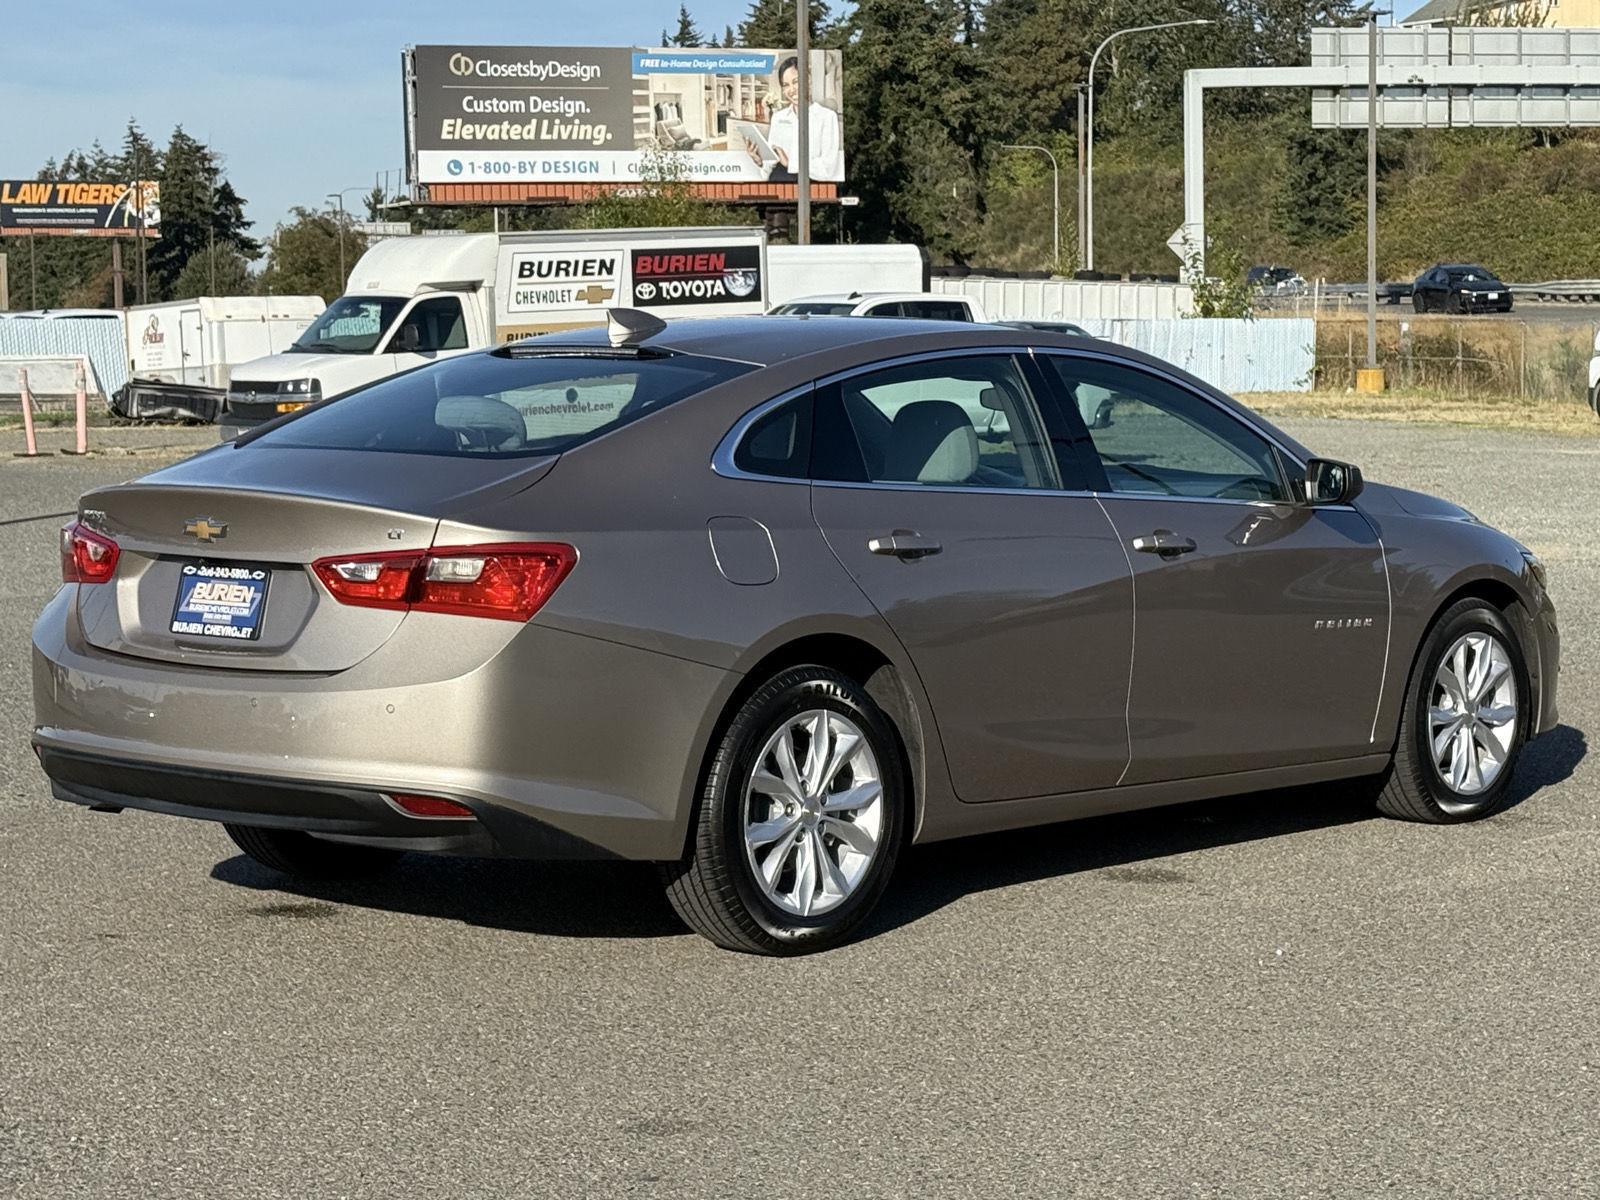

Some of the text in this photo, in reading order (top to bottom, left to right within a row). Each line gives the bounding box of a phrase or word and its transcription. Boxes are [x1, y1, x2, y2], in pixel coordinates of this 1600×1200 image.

[475, 60, 601, 81] ClosetsbyDesign
[640, 58, 660, 67] FREE
[661, 59, 692, 68] In-Home
[693, 59, 718, 70] Design
[462, 96, 591, 117] Custom Design.
[441, 118, 613, 145] Elevated Living.
[468, 161, 599, 174] 1-800-BY DESIGN
[1, 183, 128, 204] LAW TIGERS
[518, 258, 615, 279] BURIEN
[635, 253, 726, 273] BURIEN
[515, 289, 572, 305] CHEVROLET
[659, 279, 726, 299] TOYOTA
[193, 582, 255, 602] BURIEN
[172, 621, 253, 639] BURIEN CHEVROLET
